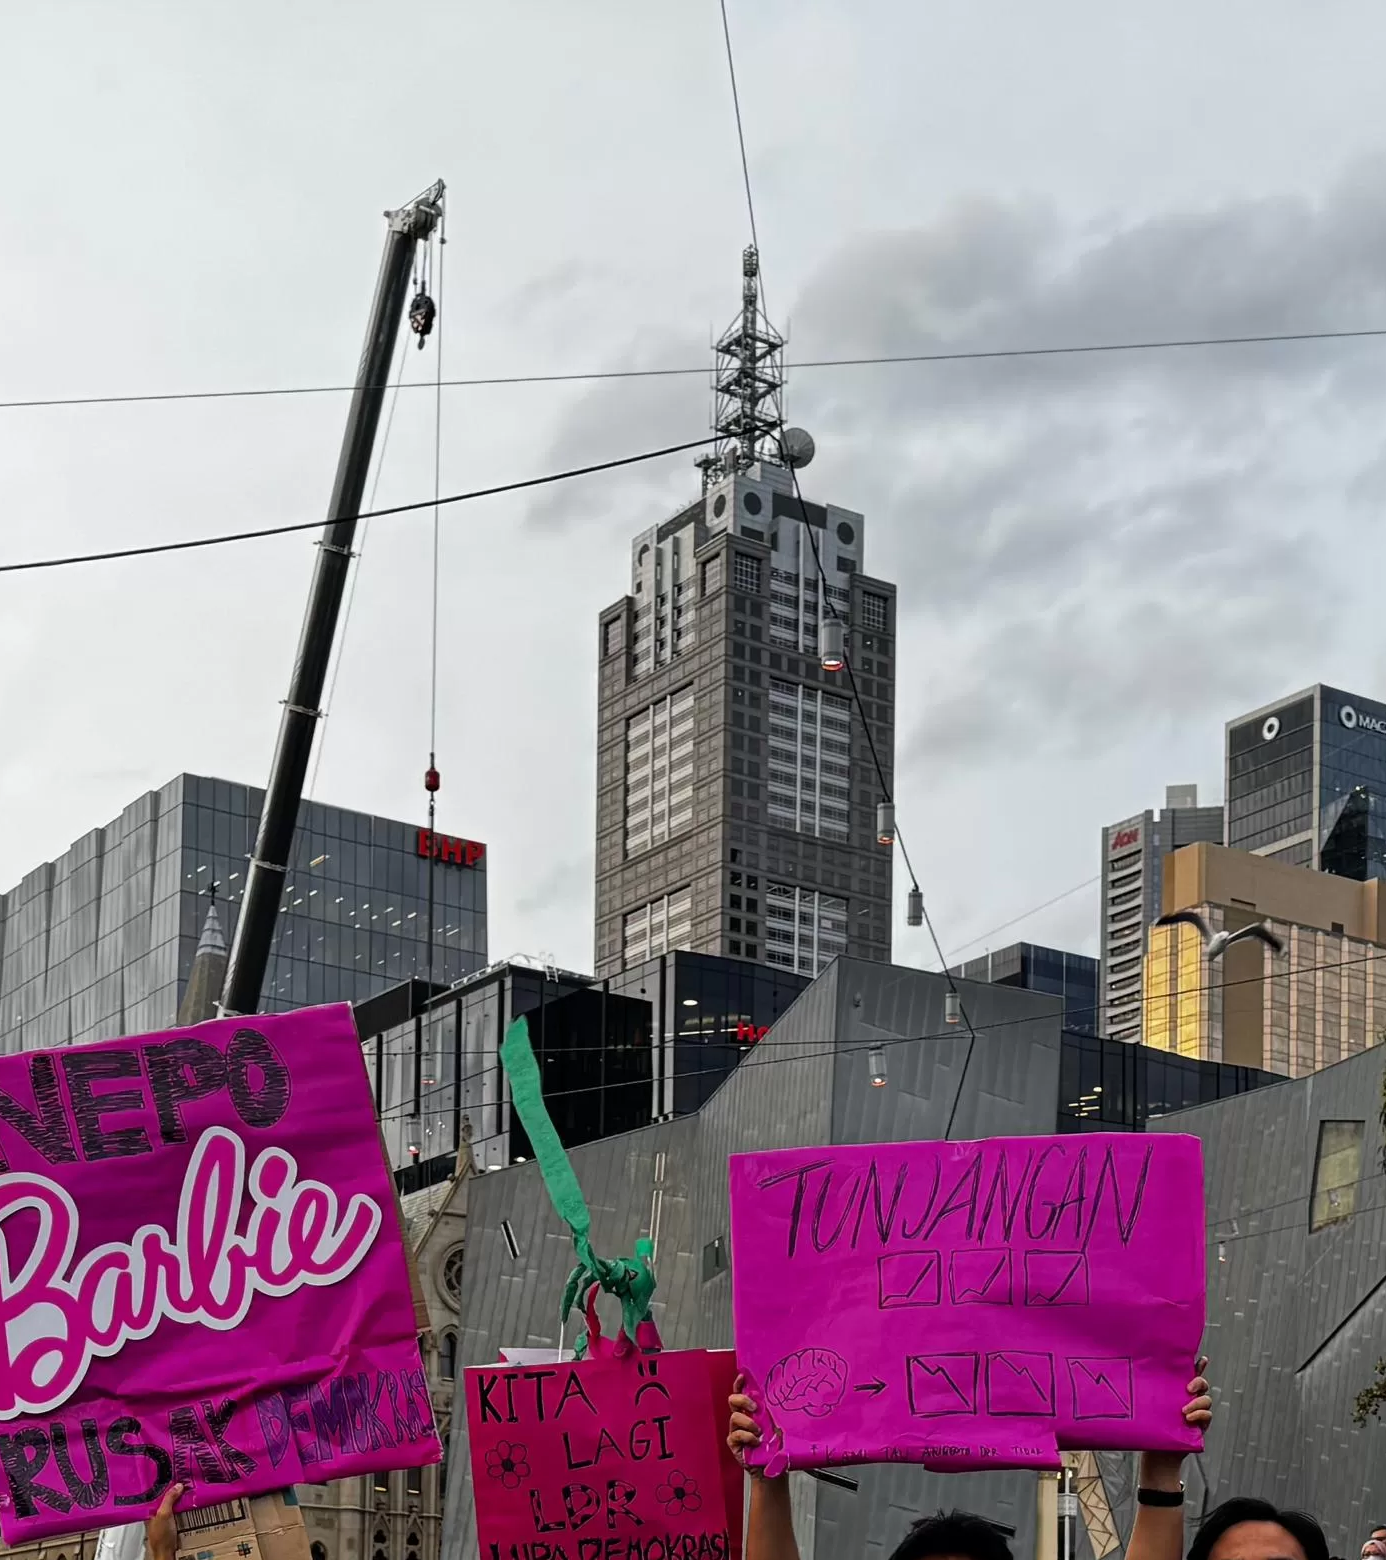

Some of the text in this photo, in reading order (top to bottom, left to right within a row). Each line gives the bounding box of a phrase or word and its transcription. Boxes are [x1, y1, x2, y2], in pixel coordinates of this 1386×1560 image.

[418, 828, 484, 866] BHP
[756, 1141, 1153, 1259] TUNJANGAN
[477, 1371, 599, 1424] KITA
[562, 1415, 674, 1470] LAGI
[529, 1479, 644, 1533] LDR
